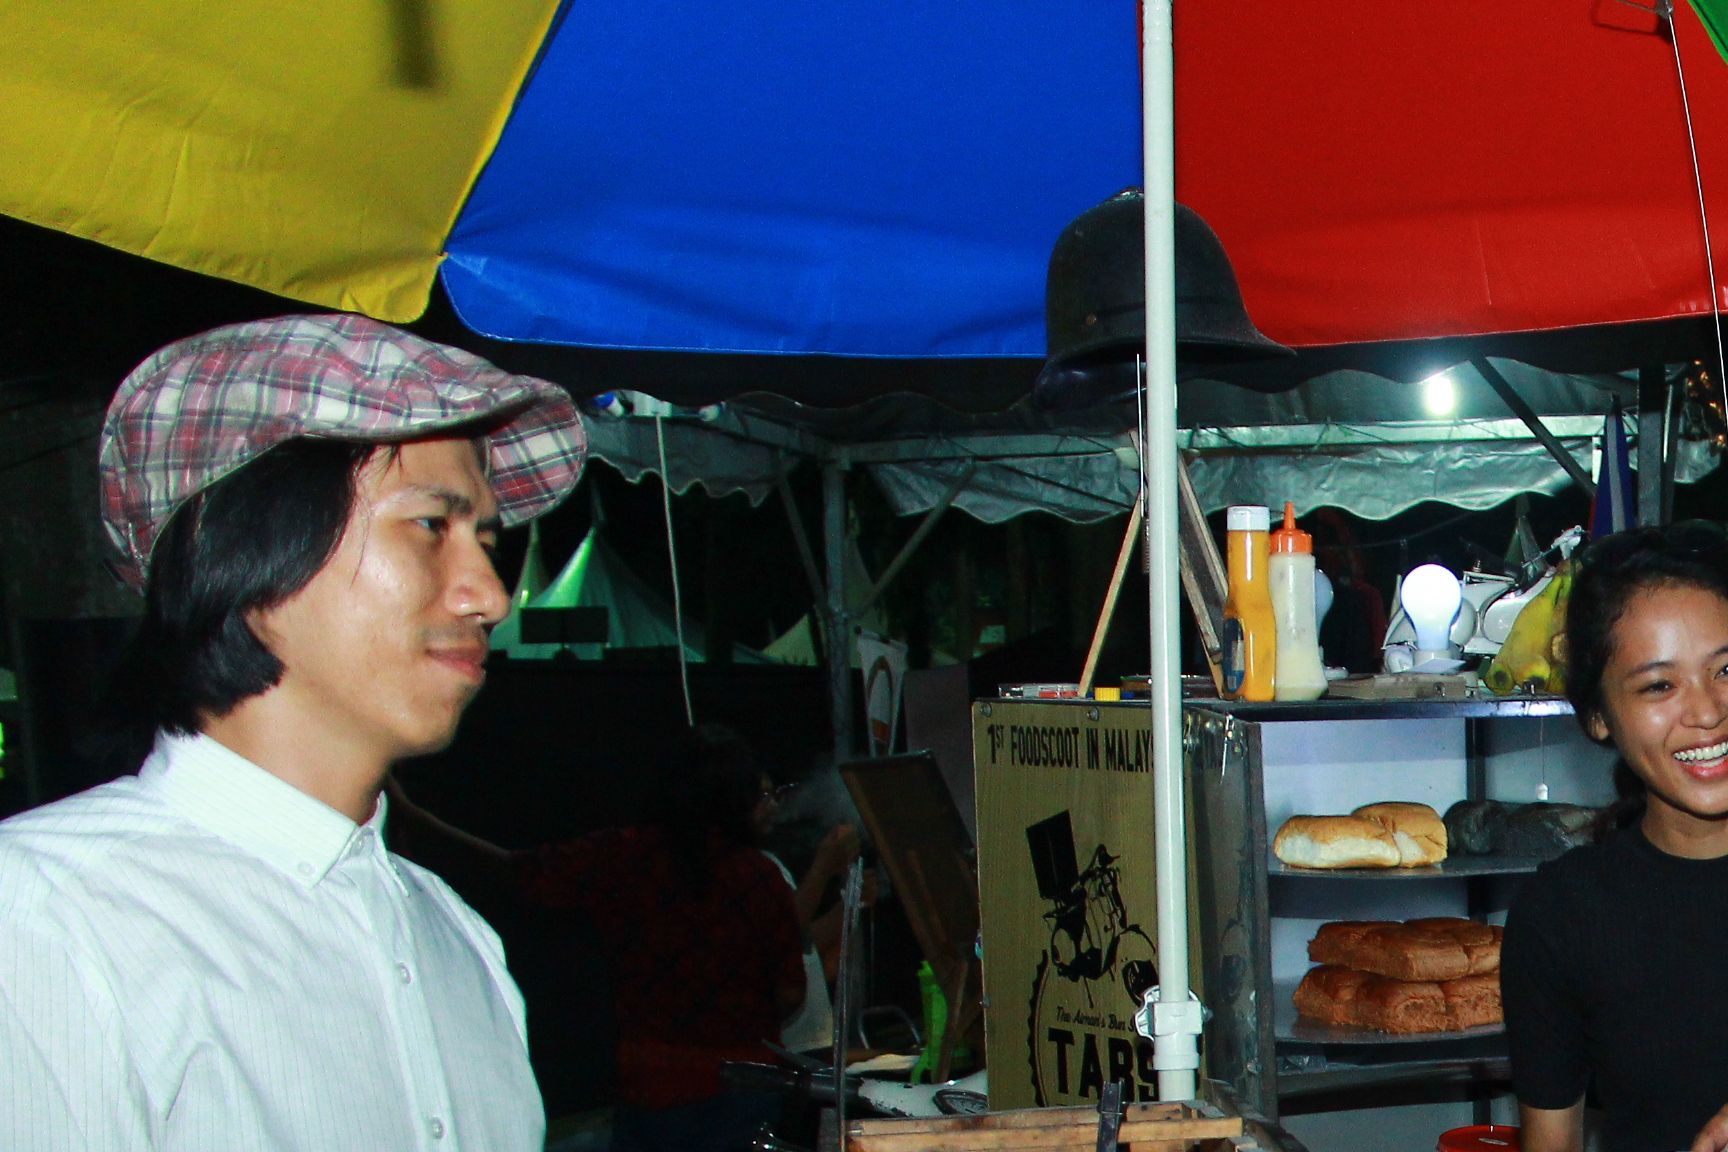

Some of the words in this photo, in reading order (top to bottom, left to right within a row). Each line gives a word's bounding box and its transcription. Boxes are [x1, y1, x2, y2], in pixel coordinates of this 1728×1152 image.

[1010, 725, 1080, 768] FOODSCOOT
[1086, 728, 1100, 770] IN
[1105, 729, 1154, 772] MALAY
[1048, 1026, 1160, 1102] TABS
